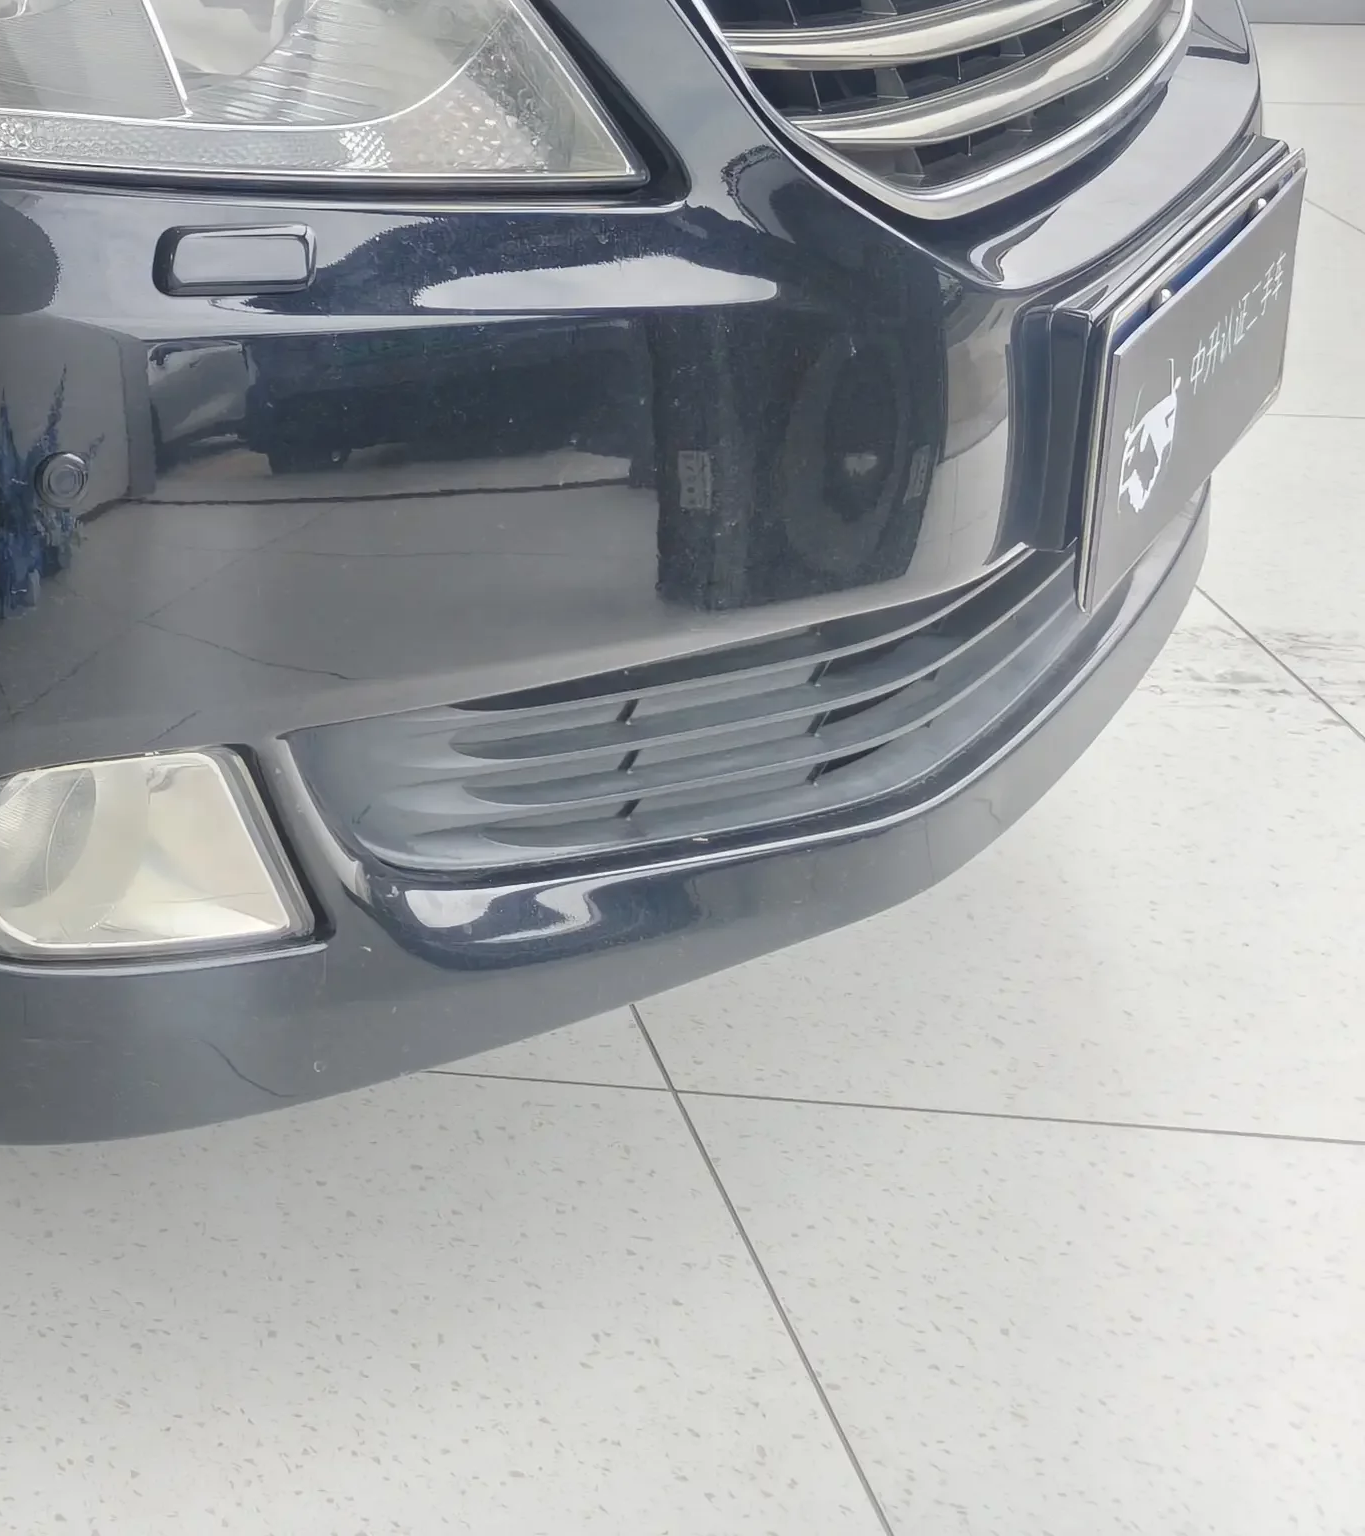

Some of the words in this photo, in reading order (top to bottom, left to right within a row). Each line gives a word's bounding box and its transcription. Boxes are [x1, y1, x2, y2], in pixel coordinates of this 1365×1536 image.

[1190, 251, 1287, 395] 中升认证二手车
